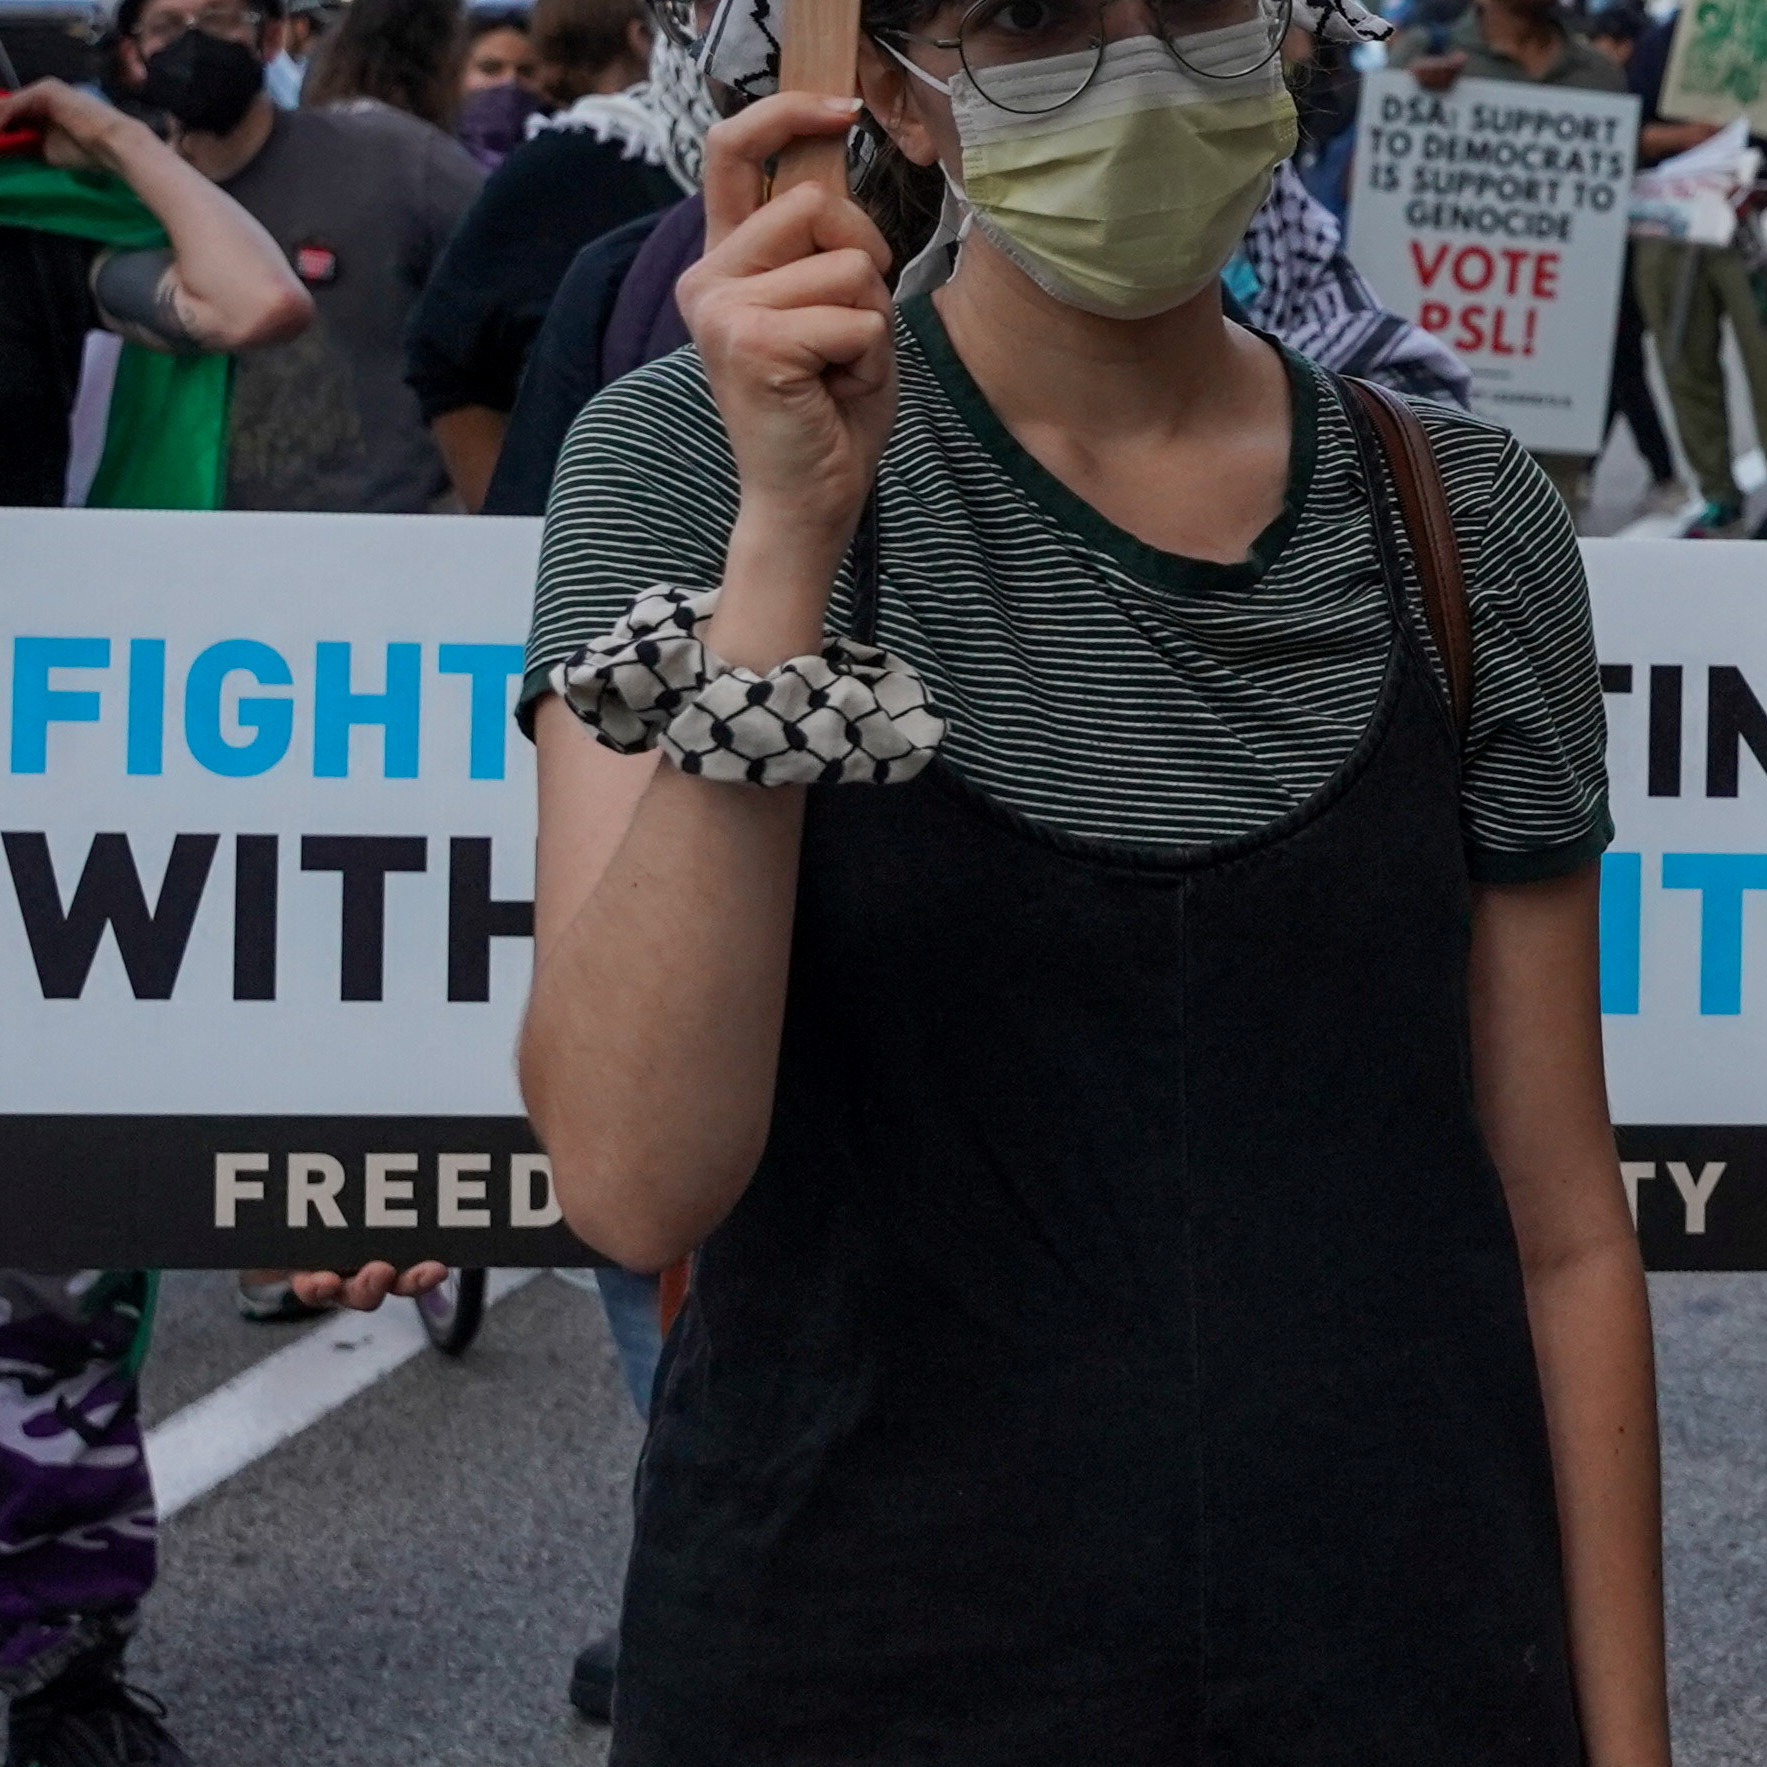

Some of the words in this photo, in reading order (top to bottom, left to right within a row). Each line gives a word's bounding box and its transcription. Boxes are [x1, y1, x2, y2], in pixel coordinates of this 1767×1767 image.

[1472, 103, 1620, 144] SUPPORT
[1370, 128, 1412, 158] TO
[1422, 133, 1626, 180] DEMOCRATS
[1369, 163, 1400, 192] IS
[1412, 166, 1560, 205] SUPPORT
[1574, 182, 1616, 214] TO
[1405, 198, 1573, 243] GENOCIDE
[1409, 239, 1562, 301] VOTE
[1419, 300, 1538, 358] PSL!
[10, 637, 524, 780] FIGHT
[3, 830, 536, 1003] WITH
[214, 1152, 565, 1229] FREED
